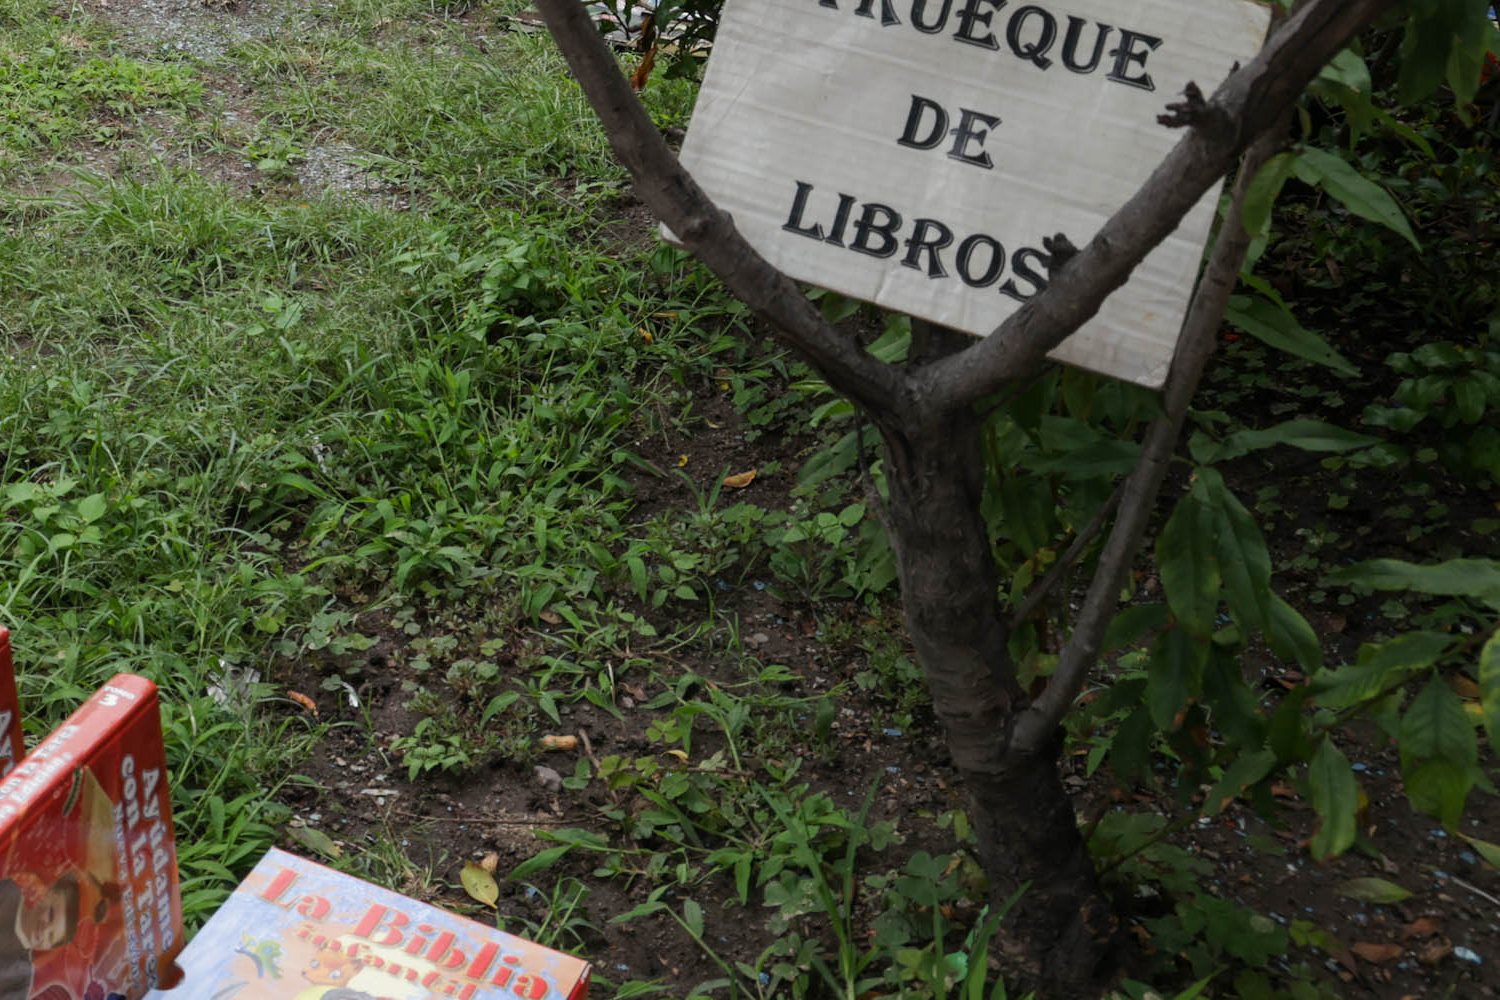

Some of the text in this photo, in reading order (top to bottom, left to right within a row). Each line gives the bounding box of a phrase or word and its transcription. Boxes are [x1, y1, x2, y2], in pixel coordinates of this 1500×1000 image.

[896, 94, 1003, 170] DE
[782, 180, 1053, 303] LIBROS
[120, 754, 142, 830] con
[130, 830, 148, 877] la
[141, 768, 176, 954] Ayúdame
[258, 867, 551, 1000] La Biblia
[298, 923, 479, 1000] infantil
